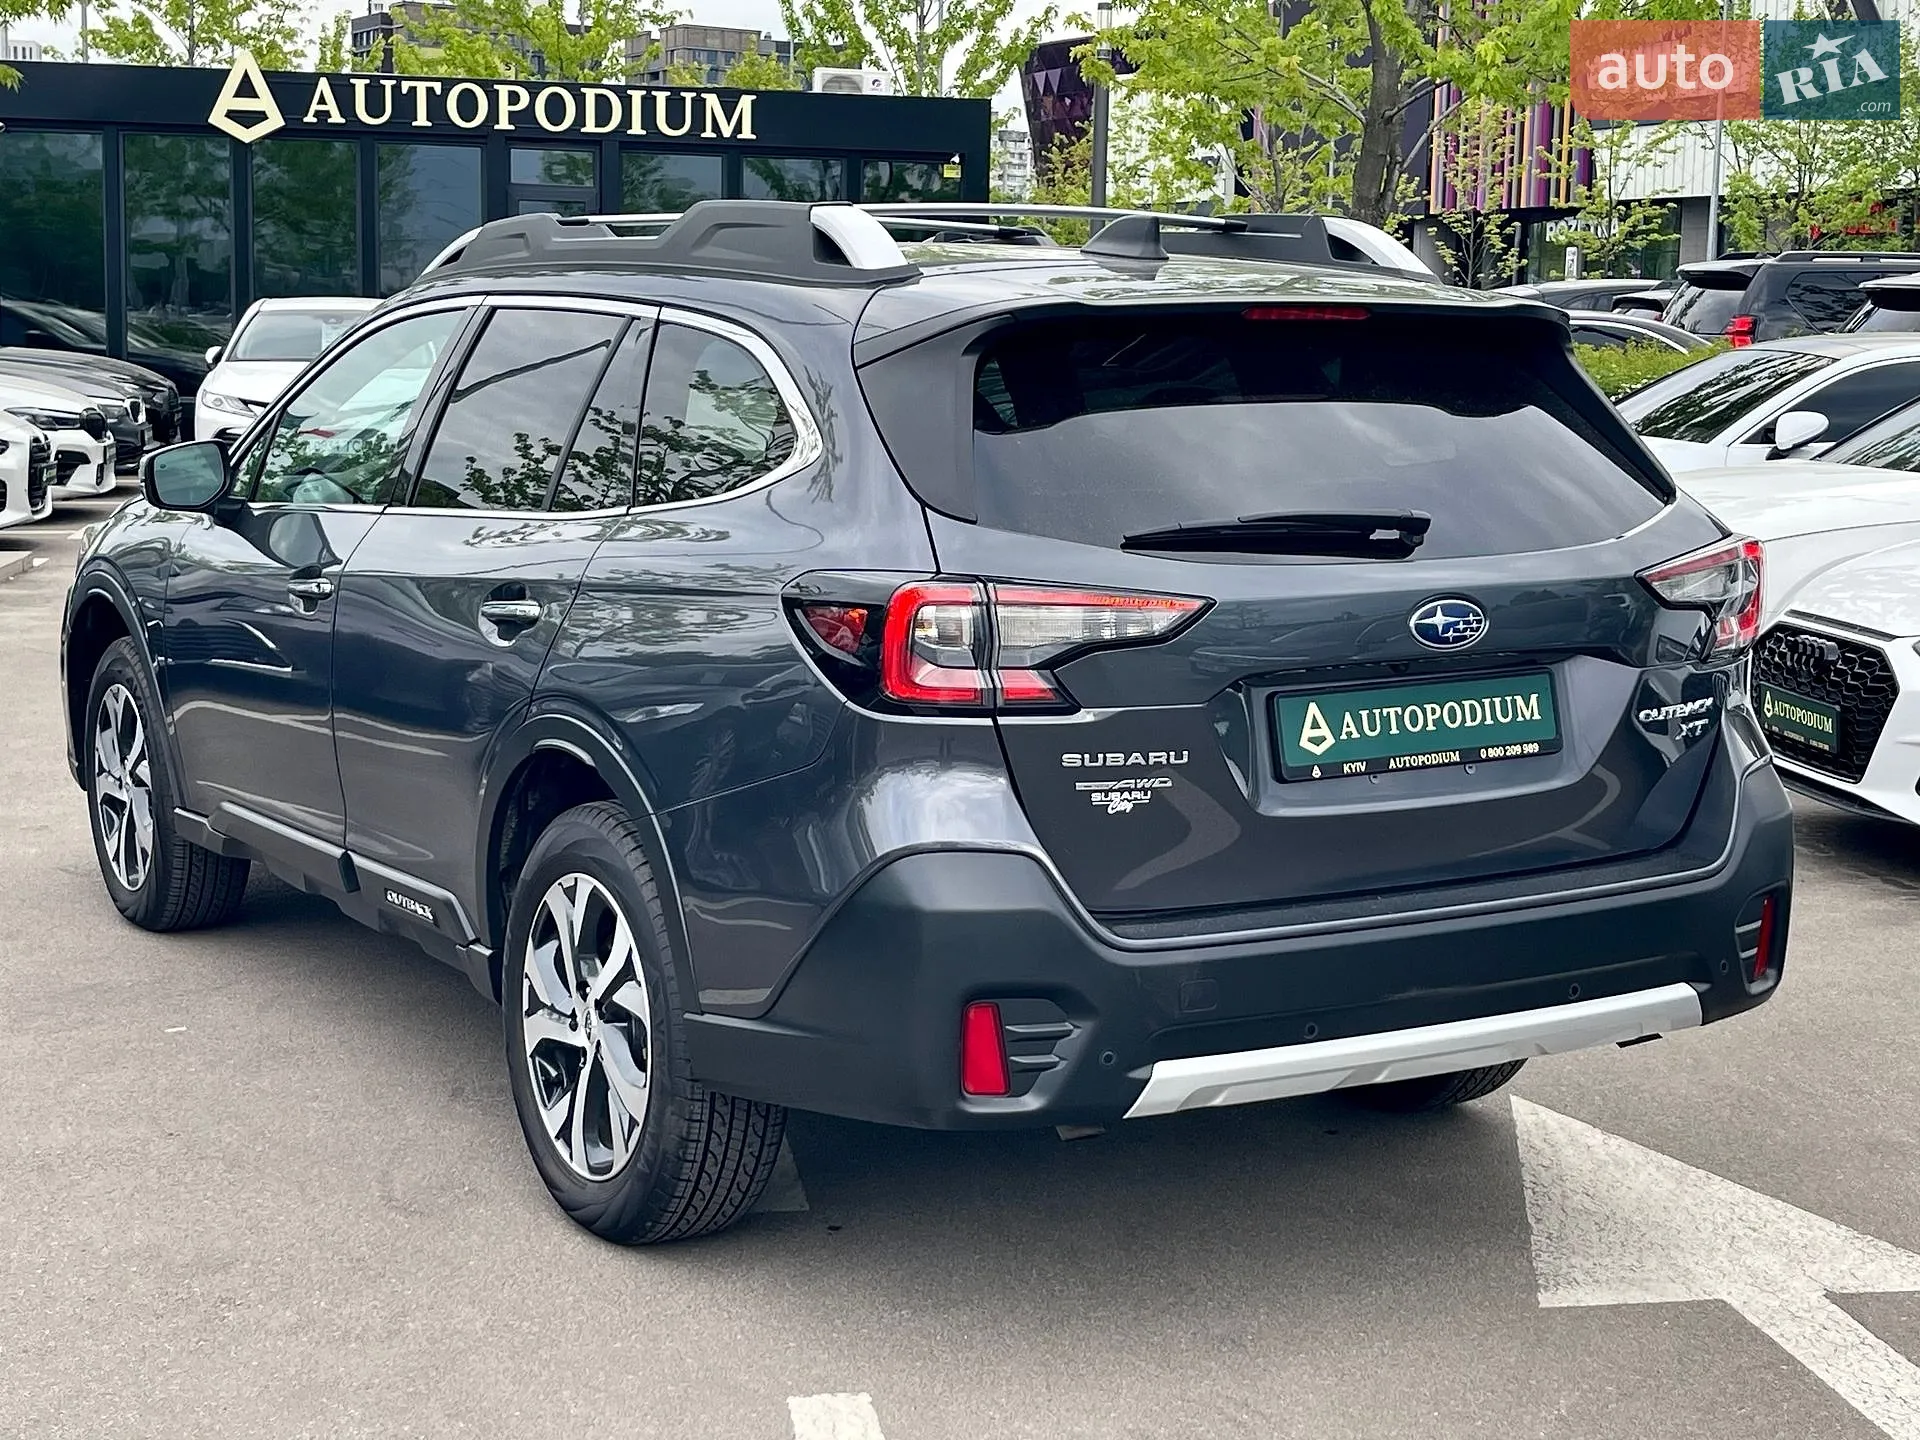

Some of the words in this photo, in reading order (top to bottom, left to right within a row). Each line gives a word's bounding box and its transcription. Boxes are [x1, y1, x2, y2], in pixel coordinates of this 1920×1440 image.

[302, 76, 757, 140] AUTOPODIUM
[1339, 693, 1542, 740] AUTOPODIUM
[1773, 700, 1833, 734] AUTOPODIUM
[1674, 719, 1709, 740] XT
[1061, 750, 1189, 767] SUBARU
[1343, 761, 1367, 774] KYIV
[1388, 751, 1461, 769] AUTOPODIUM
[1480, 748, 1487, 759] 0
[1505, 744, 1522, 756] 209
[1090, 790, 1152, 801] SUBARU
[1112, 777, 1173, 789] AWD
